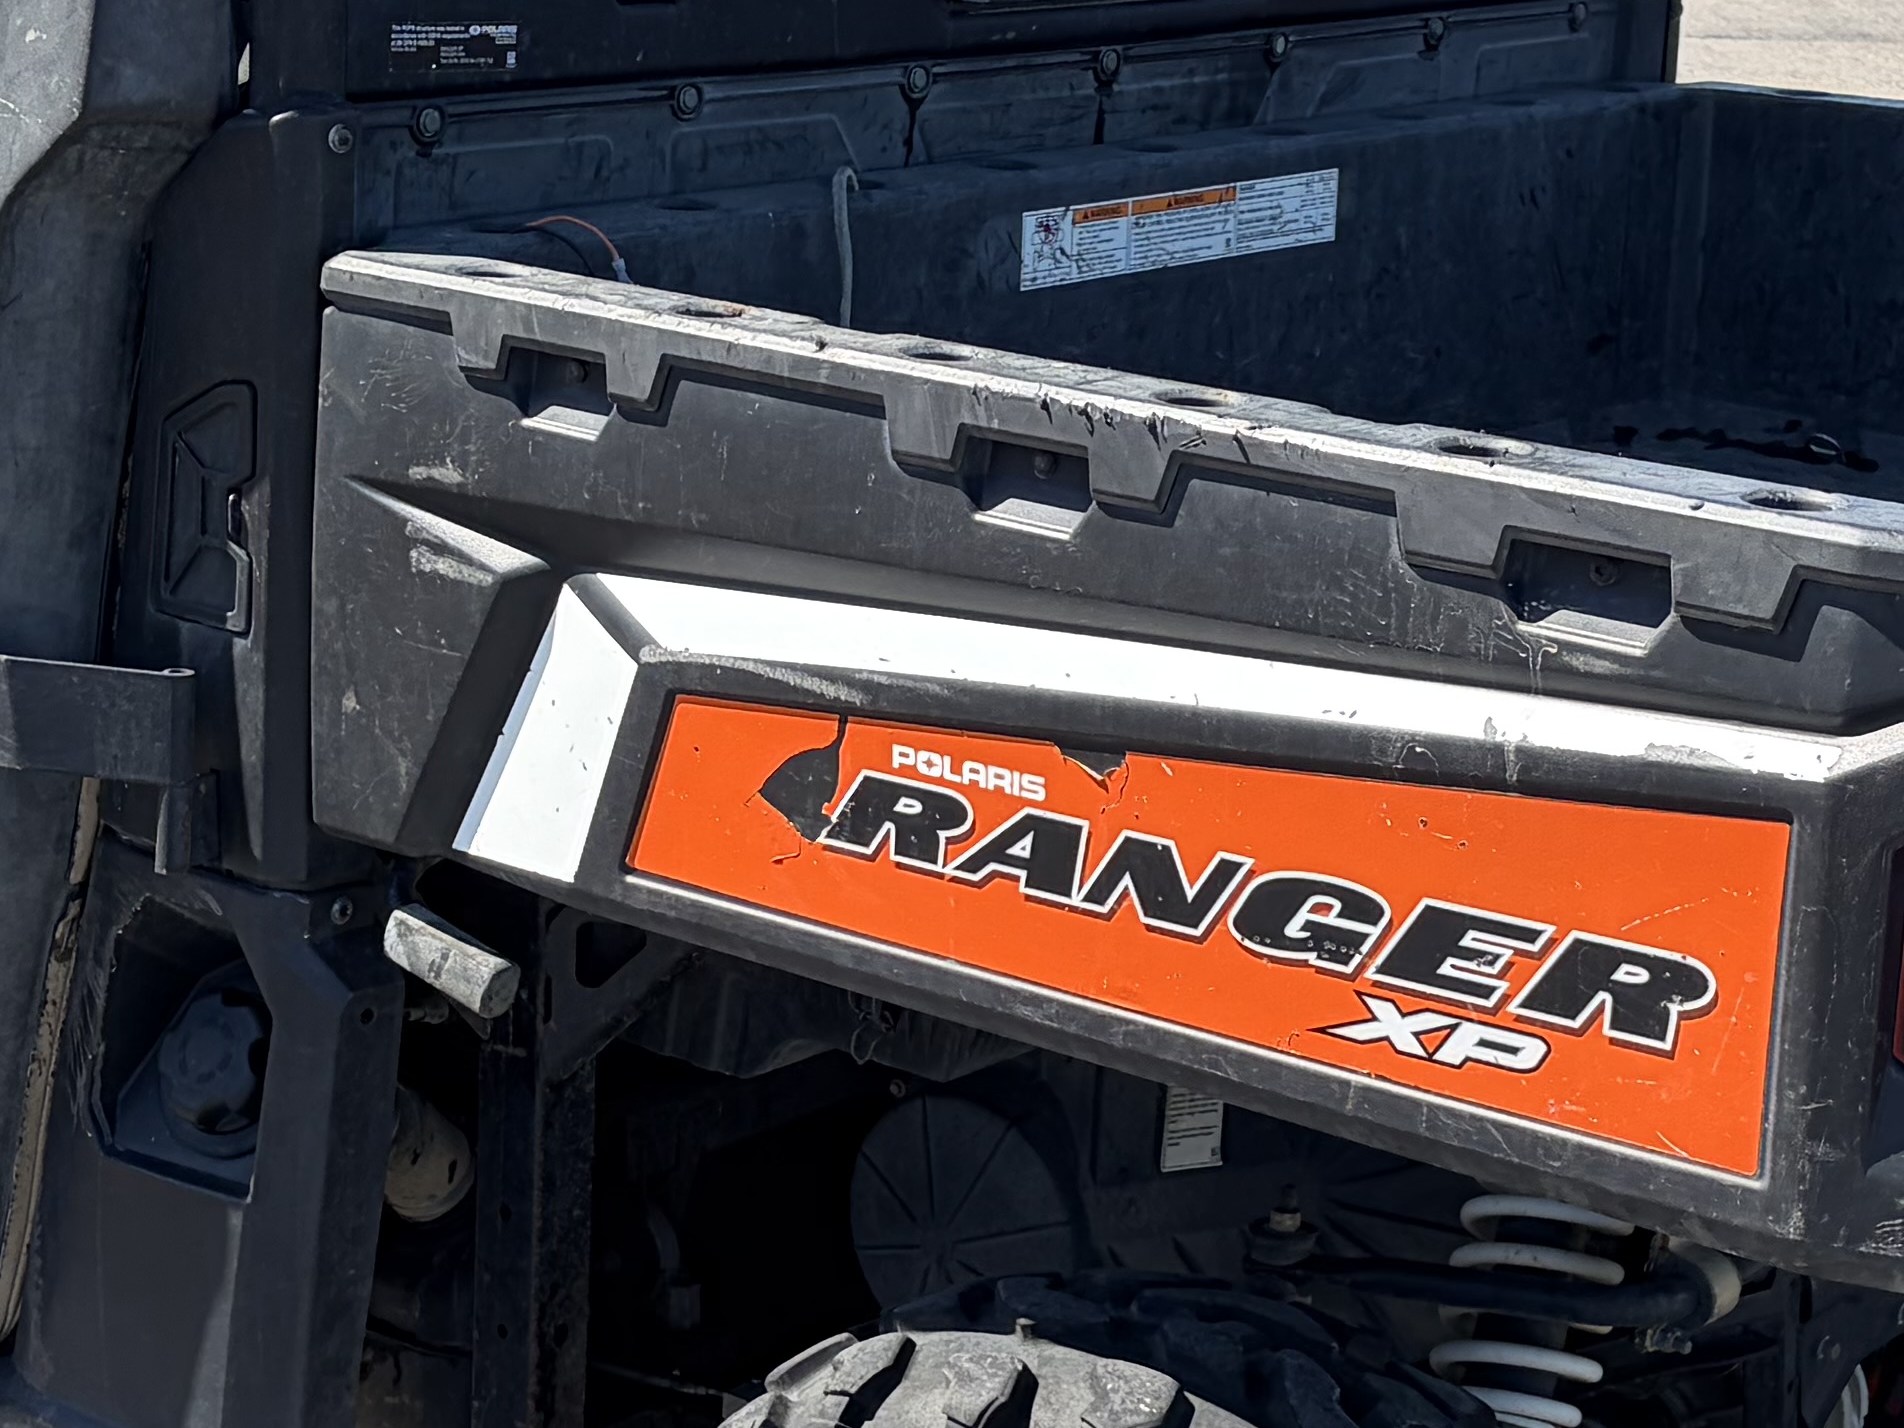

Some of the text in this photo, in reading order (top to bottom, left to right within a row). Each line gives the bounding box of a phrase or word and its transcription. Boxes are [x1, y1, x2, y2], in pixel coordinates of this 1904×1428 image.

[891, 743, 1047, 803] POLARIS
[821, 768, 1719, 1058] RANGER
[1310, 991, 1553, 1074] XP
